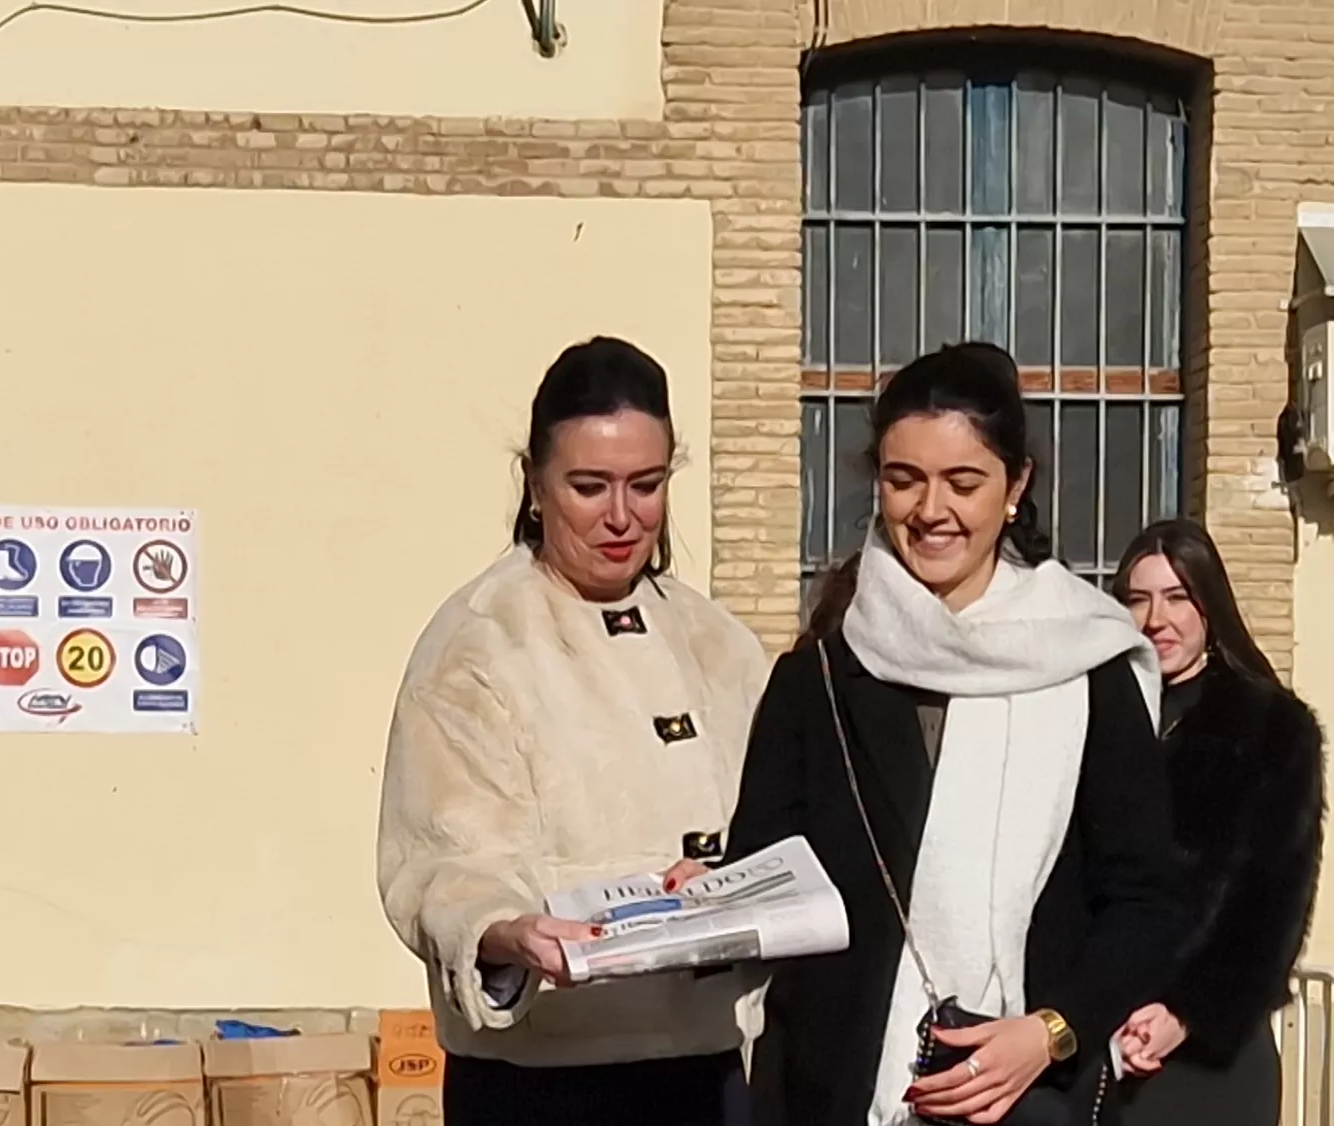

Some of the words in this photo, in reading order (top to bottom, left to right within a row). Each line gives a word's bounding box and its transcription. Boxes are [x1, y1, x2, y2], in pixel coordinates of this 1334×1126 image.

[20, 516, 59, 530] USO
[65, 516, 191, 532] OBLIGATORIO
[67, 645, 105, 672] 20
